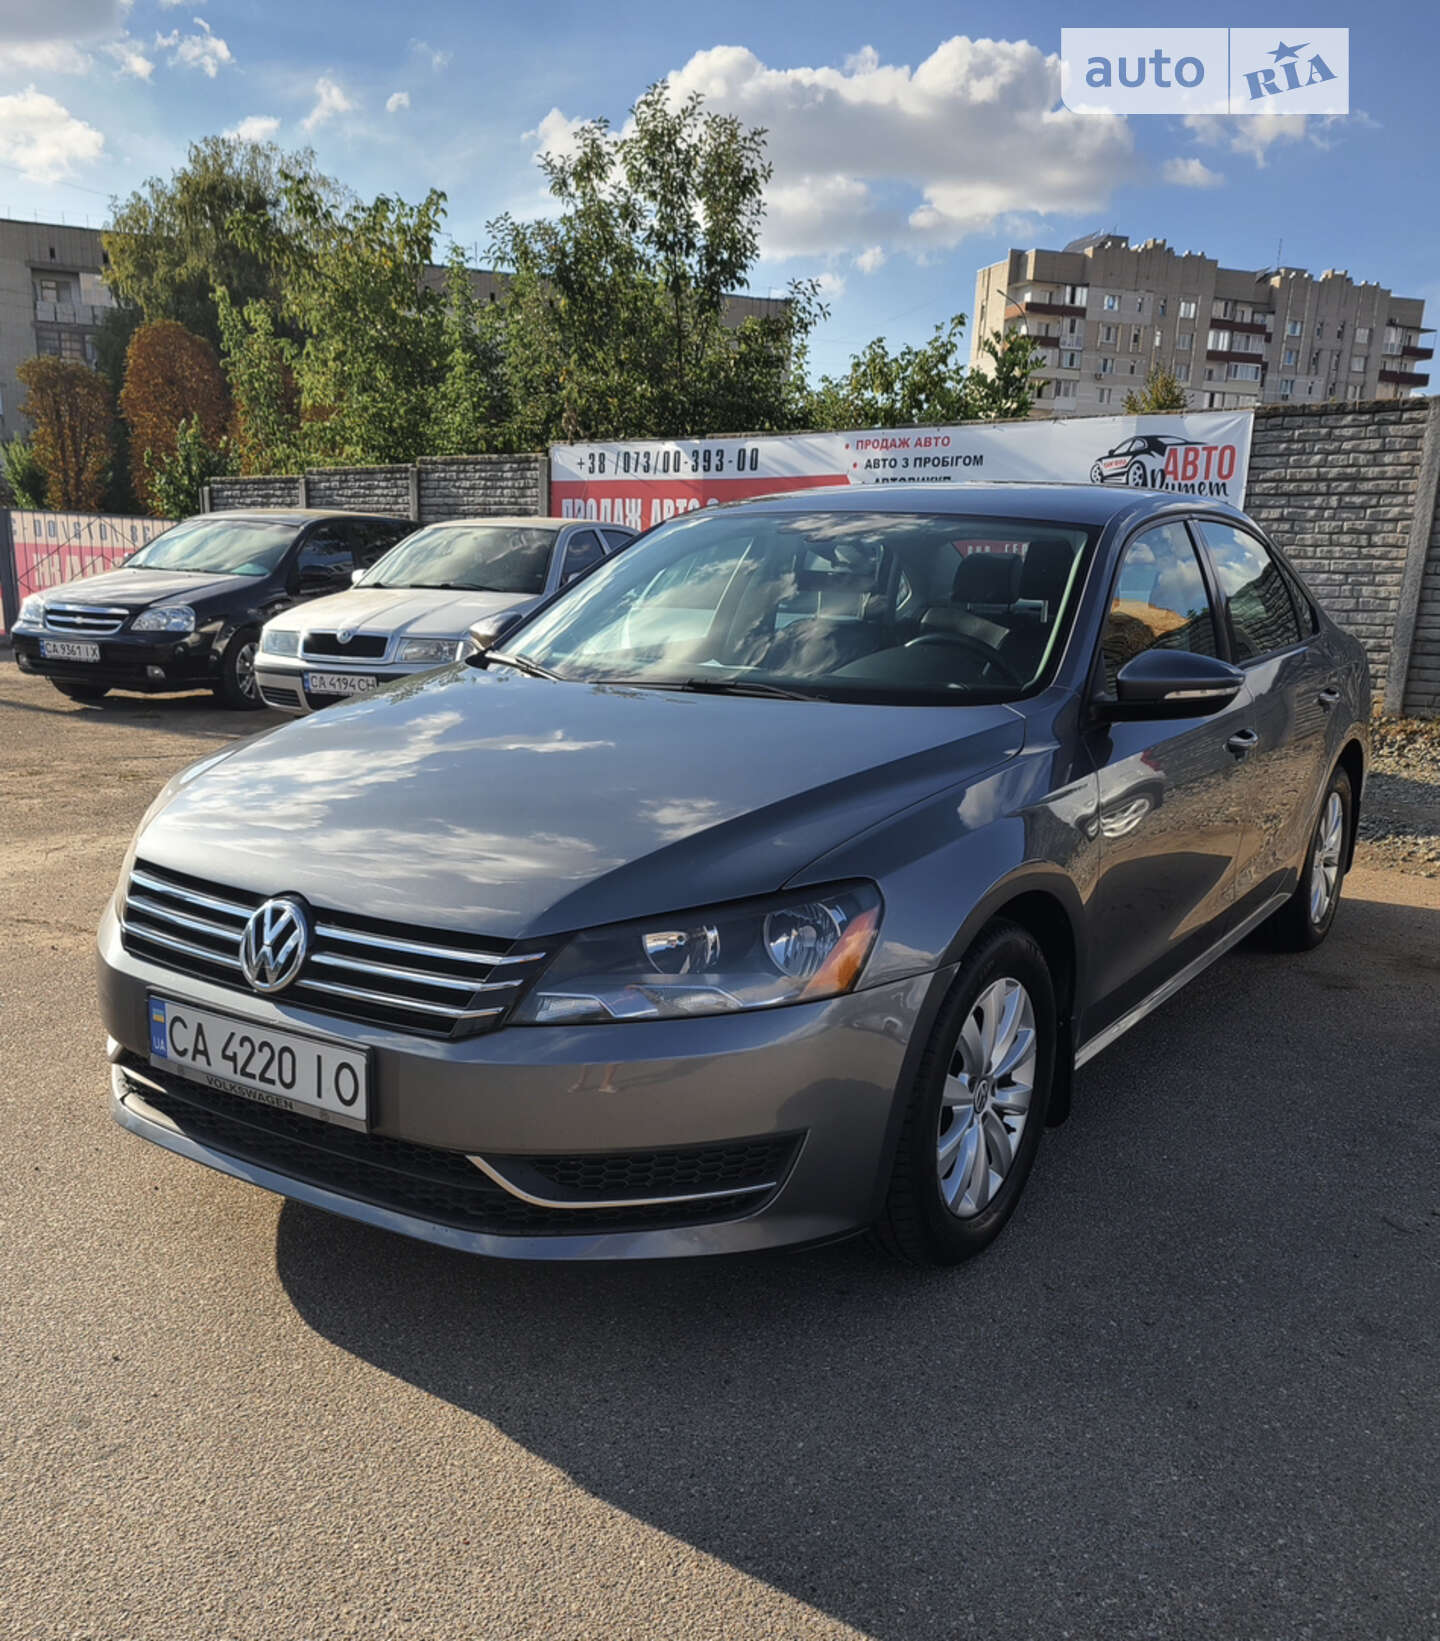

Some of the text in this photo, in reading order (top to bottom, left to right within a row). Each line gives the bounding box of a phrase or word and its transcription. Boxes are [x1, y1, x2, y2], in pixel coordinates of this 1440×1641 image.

[856, 435, 952, 451] ПРОДАЖ АВТО
[577, 452, 606, 475] +38
[864, 457, 898, 470] АВТО
[913, 455, 984, 468] ПРОБІГОМ
[1163, 444, 1237, 481] АВТО
[329, 676, 356, 690] 4194
[169, 1015, 212, 1067] CA
[221, 1032, 297, 1089] 4220
[205, 1075, 294, 1110] VOLKSWAGEN
